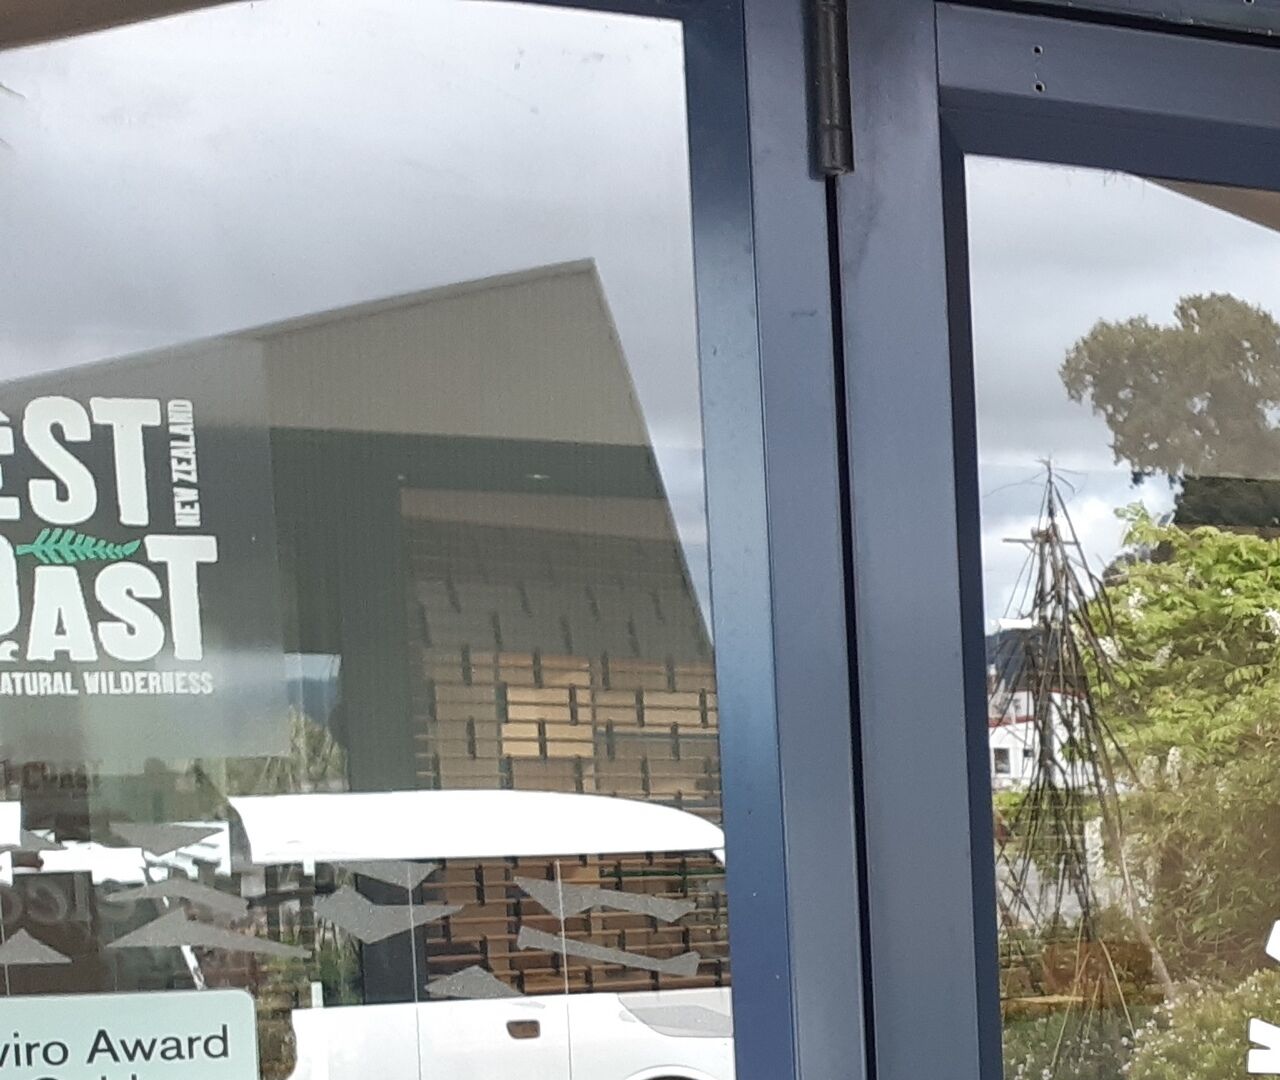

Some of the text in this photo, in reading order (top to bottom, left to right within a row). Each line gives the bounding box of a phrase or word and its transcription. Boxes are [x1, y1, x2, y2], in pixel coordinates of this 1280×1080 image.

[167, 399, 201, 527] NEW ZEALAND
[83, 672, 214, 695] WILDERNESS
[87, 1024, 229, 1065] Award
